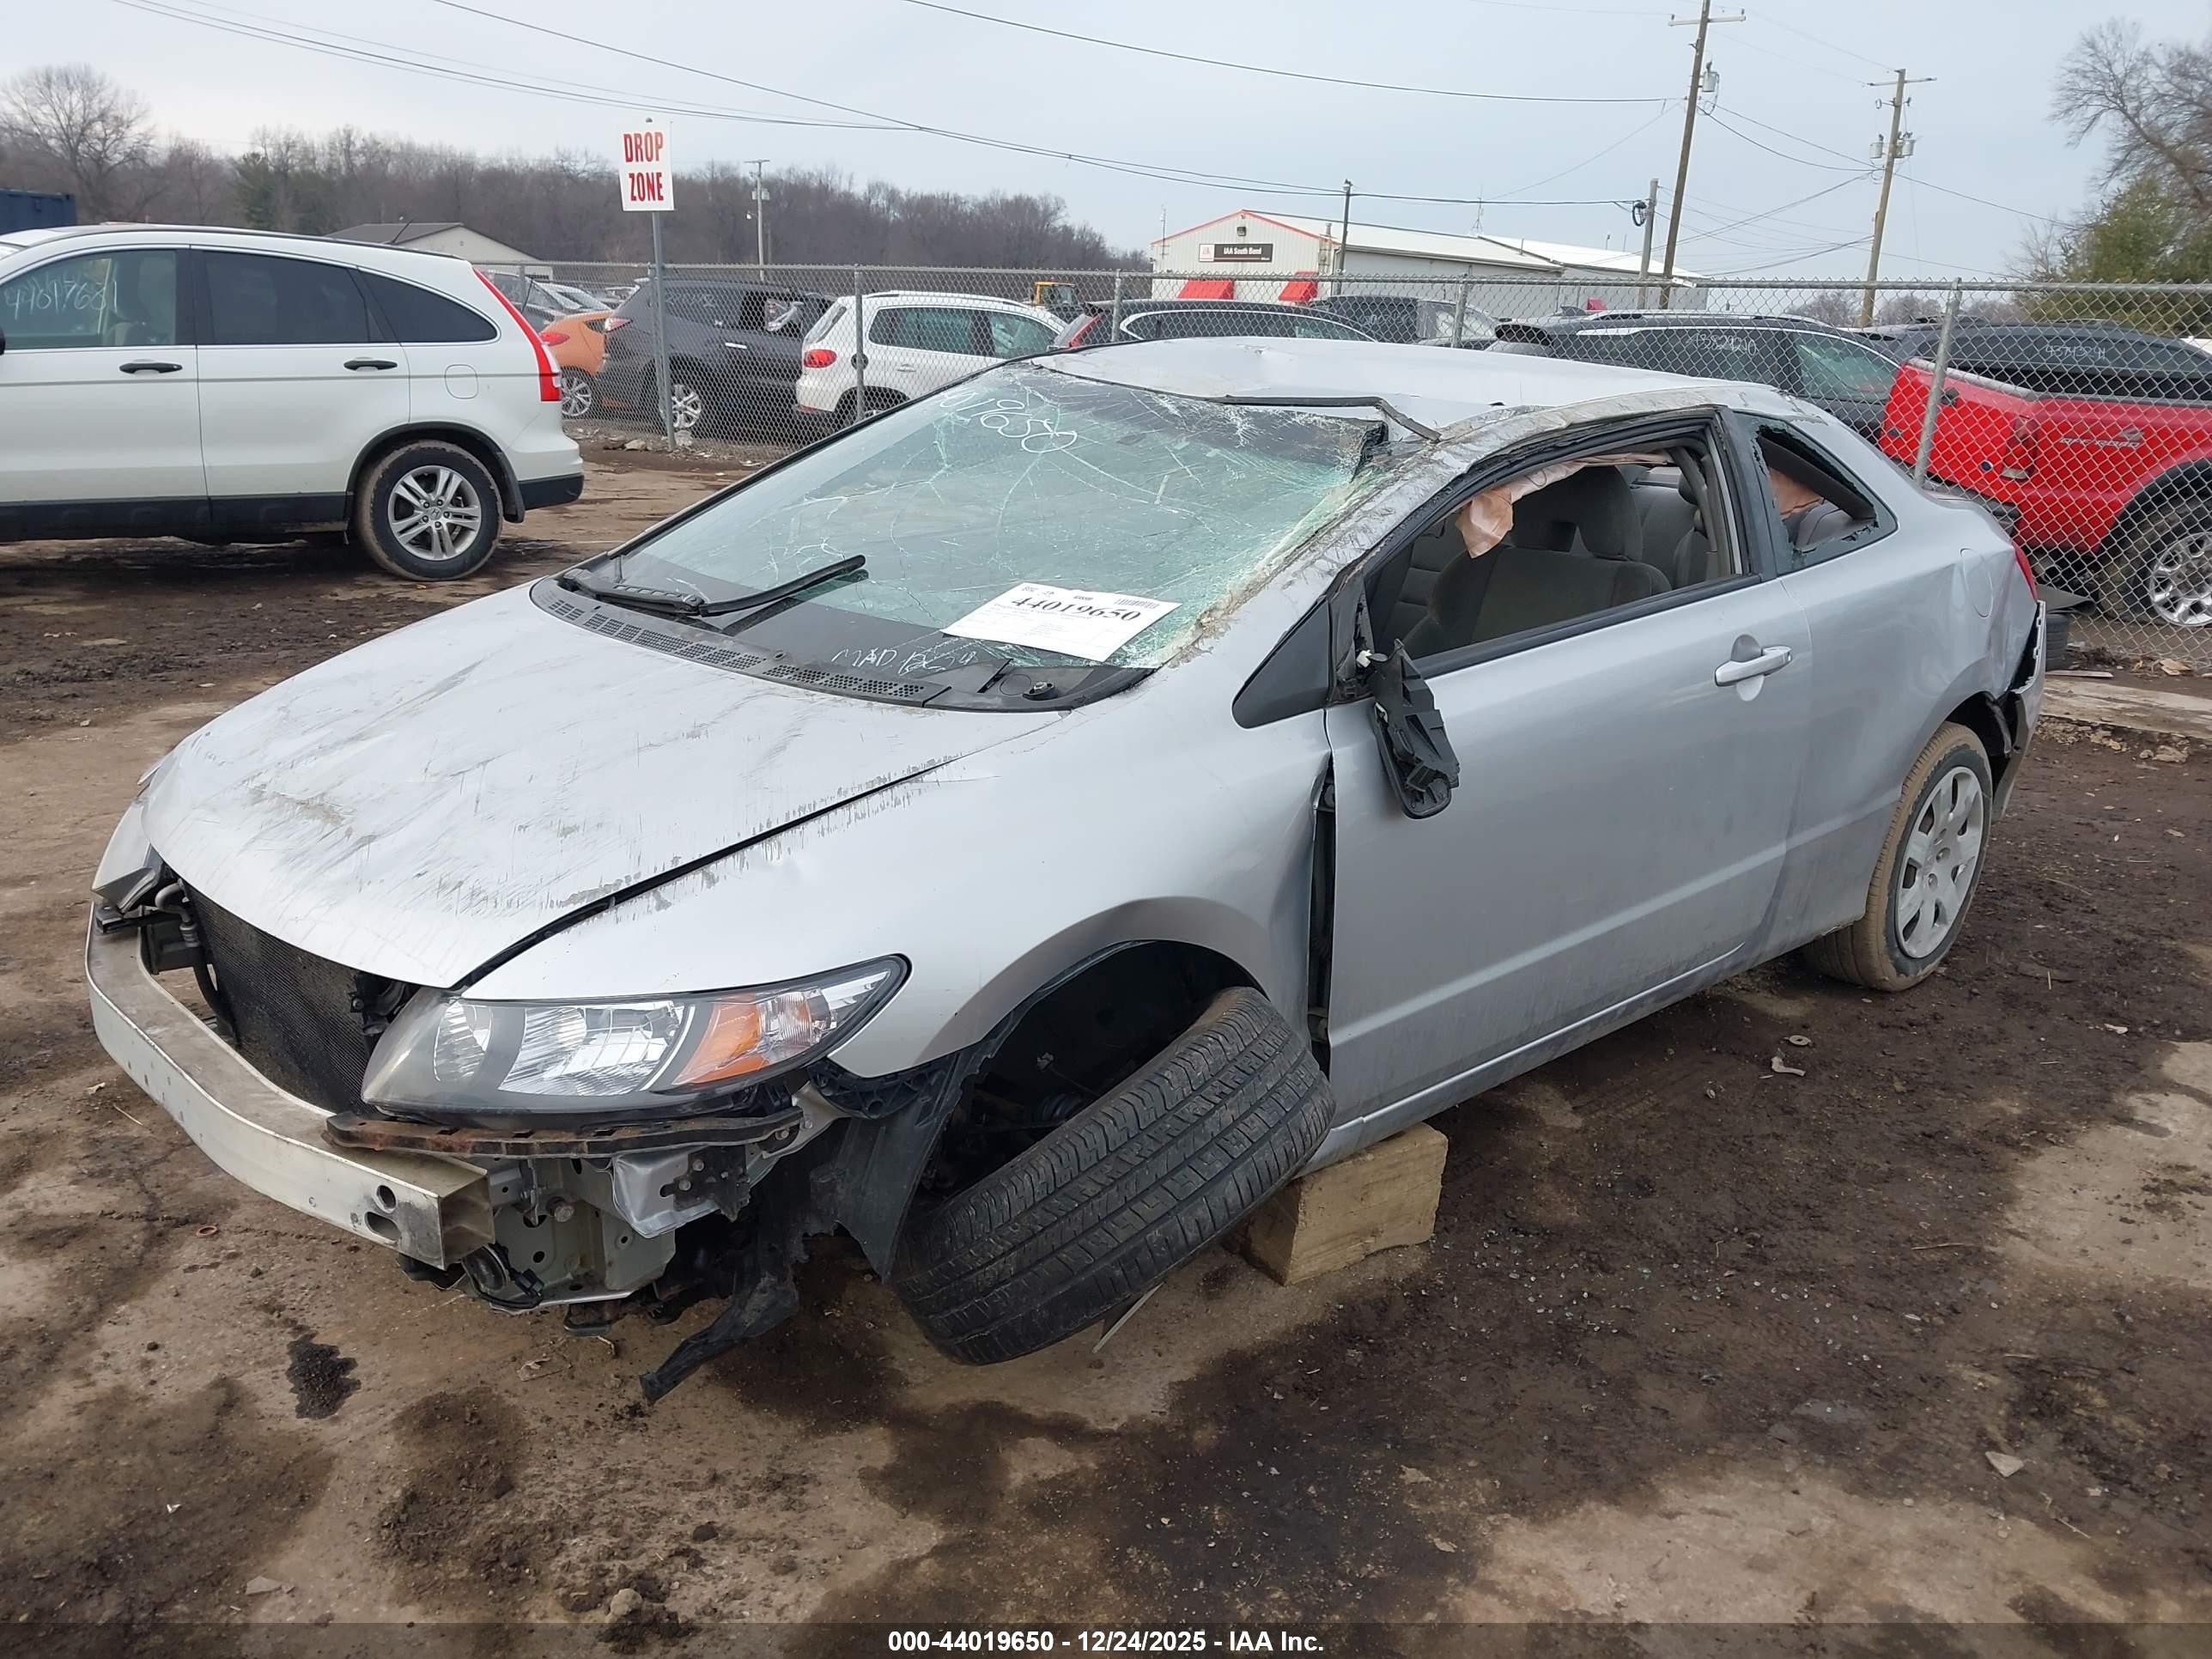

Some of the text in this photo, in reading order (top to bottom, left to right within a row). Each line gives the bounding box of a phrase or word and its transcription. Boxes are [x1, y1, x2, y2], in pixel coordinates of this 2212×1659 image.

[623, 131, 664, 163] DROP
[629, 172, 665, 202] ZONE
[1011, 597, 1142, 622] 44019650
